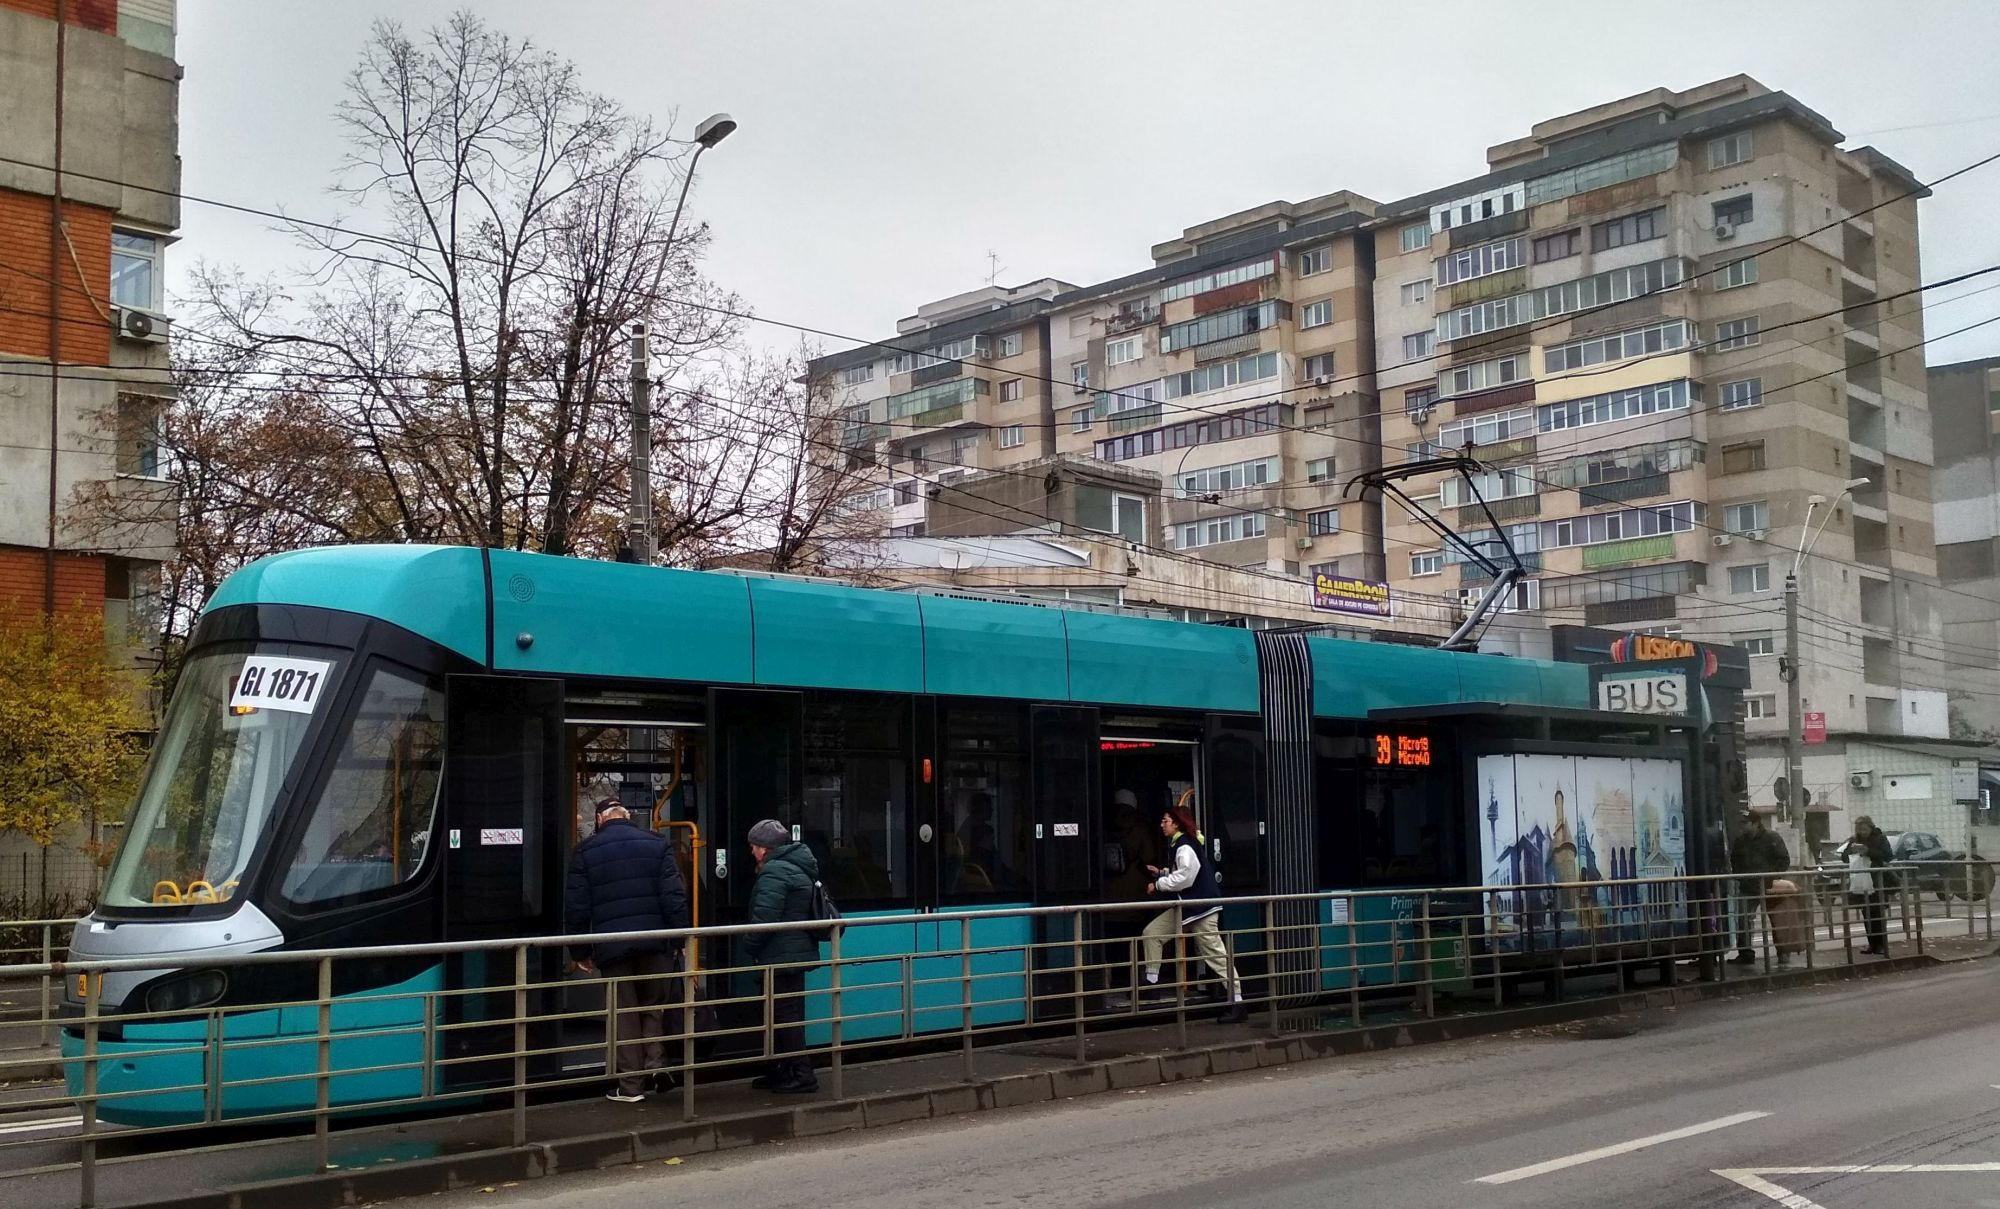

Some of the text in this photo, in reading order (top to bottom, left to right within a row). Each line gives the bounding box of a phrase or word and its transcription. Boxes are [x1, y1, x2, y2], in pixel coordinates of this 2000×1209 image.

[240, 666, 320, 702] GL 1871
[1606, 680, 1678, 712] BUS
[1376, 735, 1391, 764] 39
